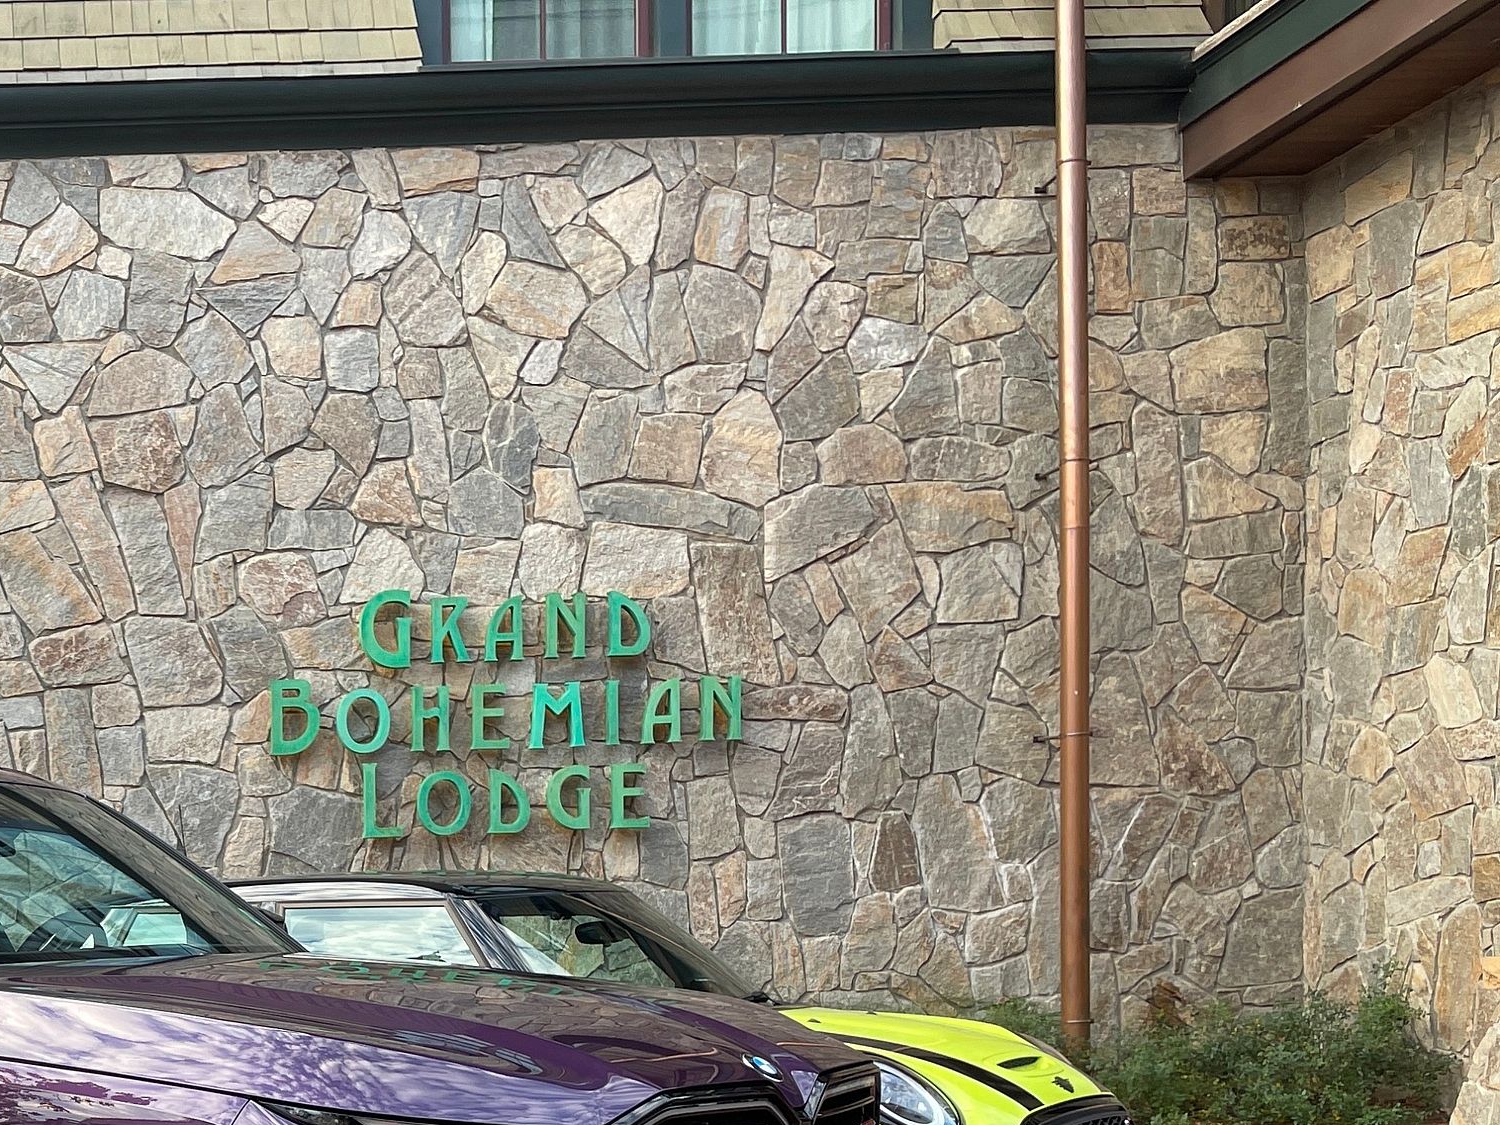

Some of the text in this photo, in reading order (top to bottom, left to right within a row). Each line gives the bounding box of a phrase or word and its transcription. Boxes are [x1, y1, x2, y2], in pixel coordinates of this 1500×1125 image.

[359, 588, 651, 669] GRAND
[268, 675, 743, 756] BOHEMIAN
[362, 762, 651, 840] LODGE
